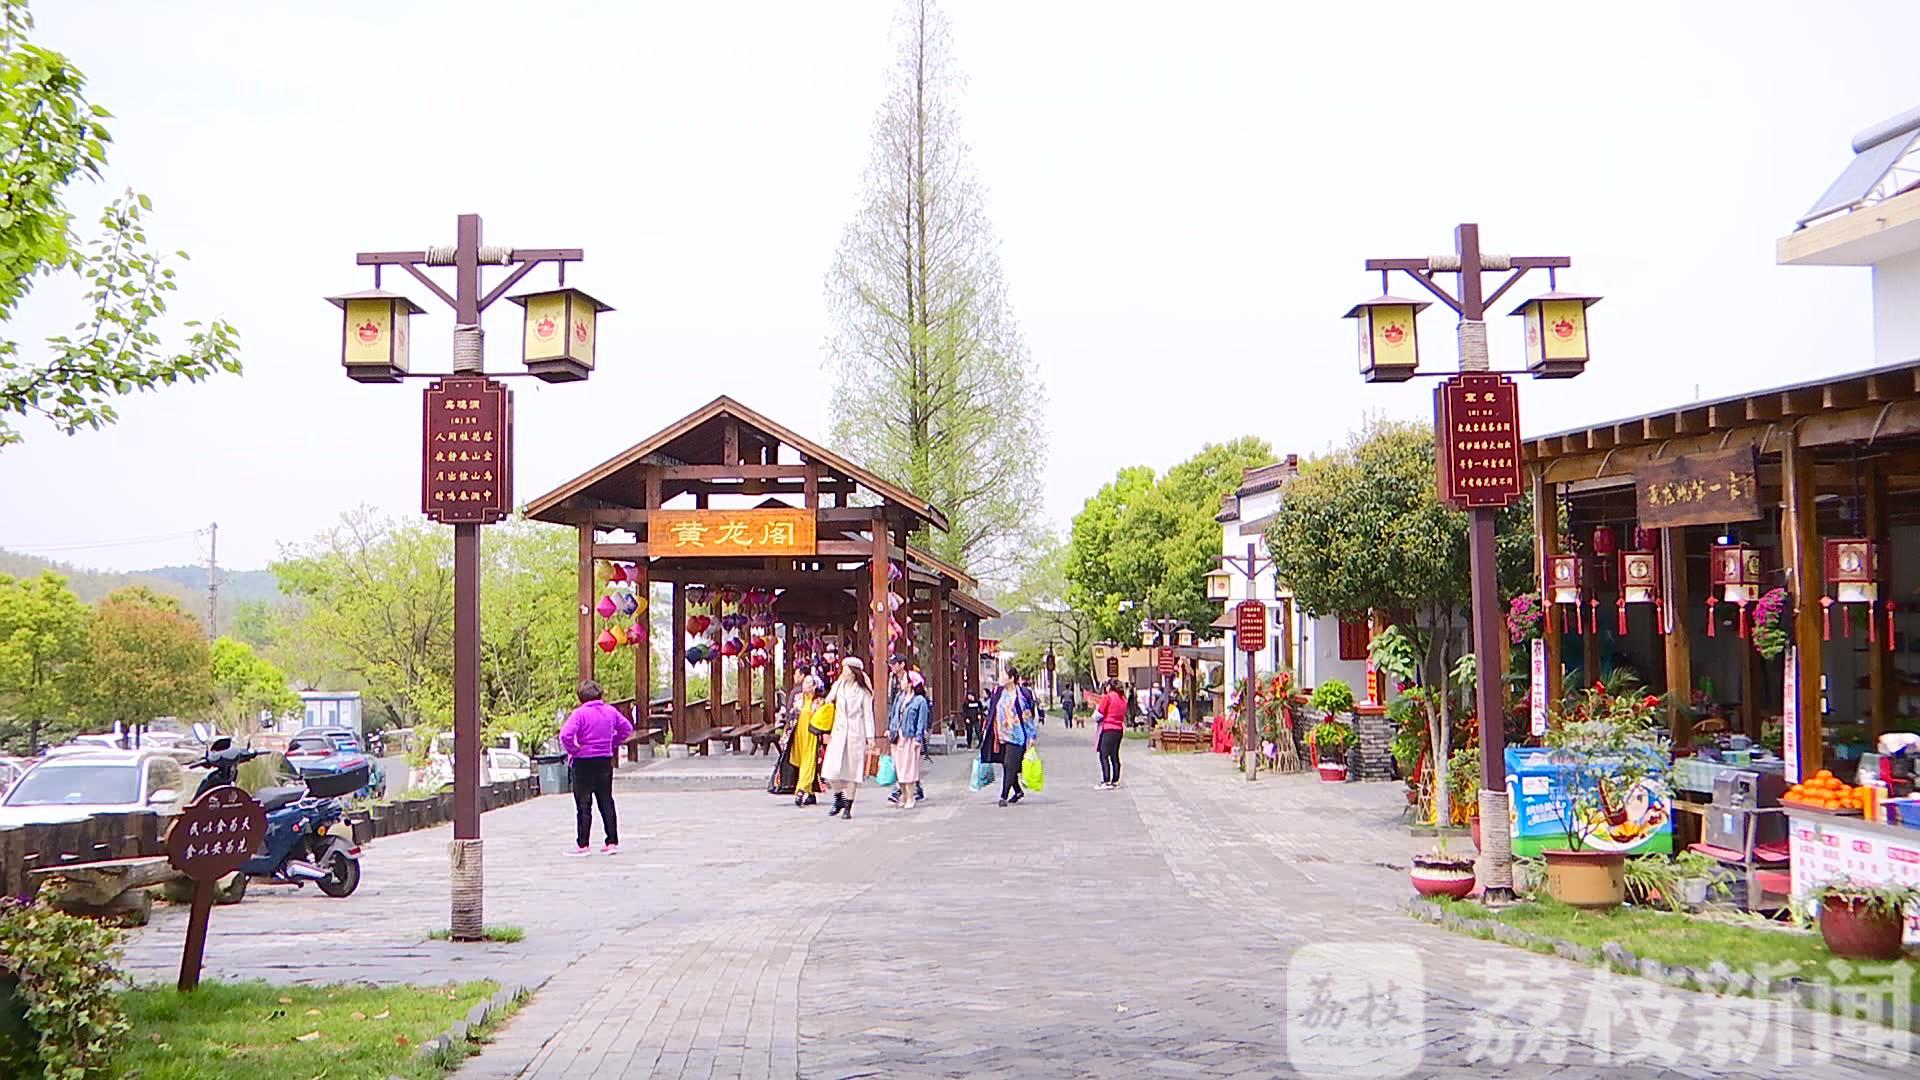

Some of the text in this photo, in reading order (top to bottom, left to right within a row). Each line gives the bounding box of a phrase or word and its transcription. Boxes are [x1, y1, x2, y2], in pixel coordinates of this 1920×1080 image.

[670, 520, 795, 548] 黄龙阁
[189, 815, 251, 837] 民以食为天
[185, 836, 248, 860] 食以安为先
